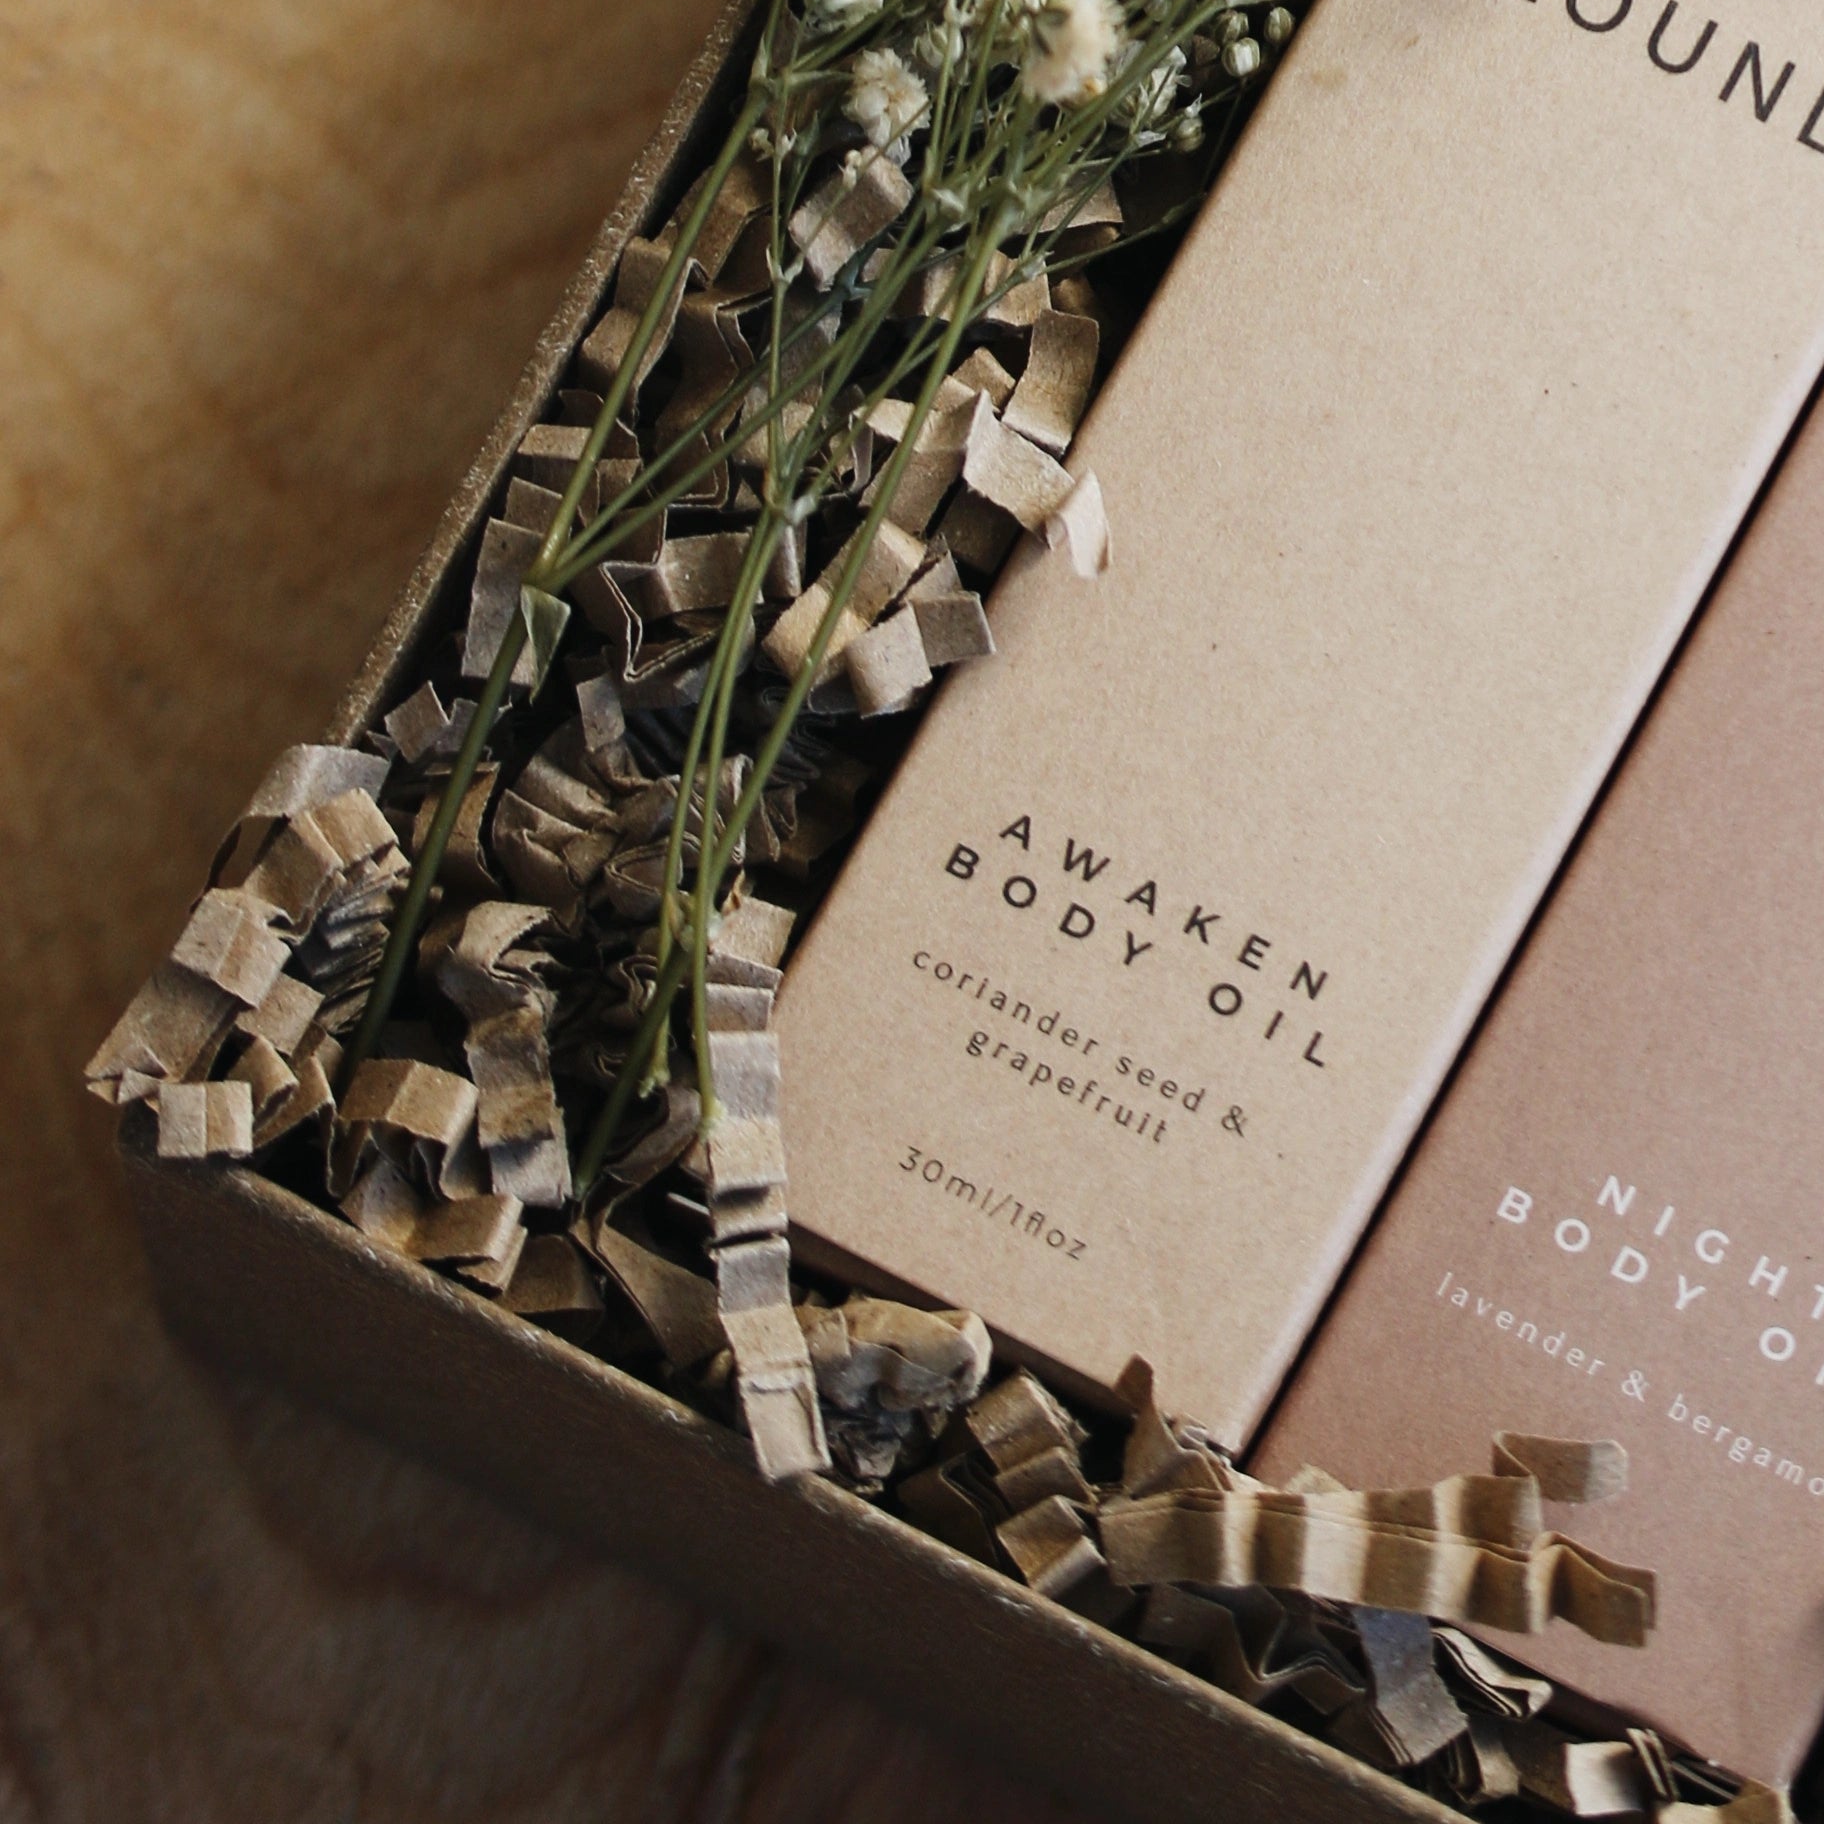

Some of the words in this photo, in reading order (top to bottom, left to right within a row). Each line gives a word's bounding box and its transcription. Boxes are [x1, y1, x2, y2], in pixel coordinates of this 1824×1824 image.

[944, 843, 1154, 967] BODY
[1207, 982, 1325, 1069] OIL
[998, 814, 1329, 1001] AWAKEN
[912, 951, 1100, 1056] coriander
[1115, 1056, 1207, 1114] seed
[1220, 1104, 1248, 1138] &
[965, 1031, 1167, 1145] grapefruit
[1497, 1186, 1706, 1311] BODY
[1436, 1272, 1605, 1376] lavender
[1621, 1370, 1649, 1402] &
